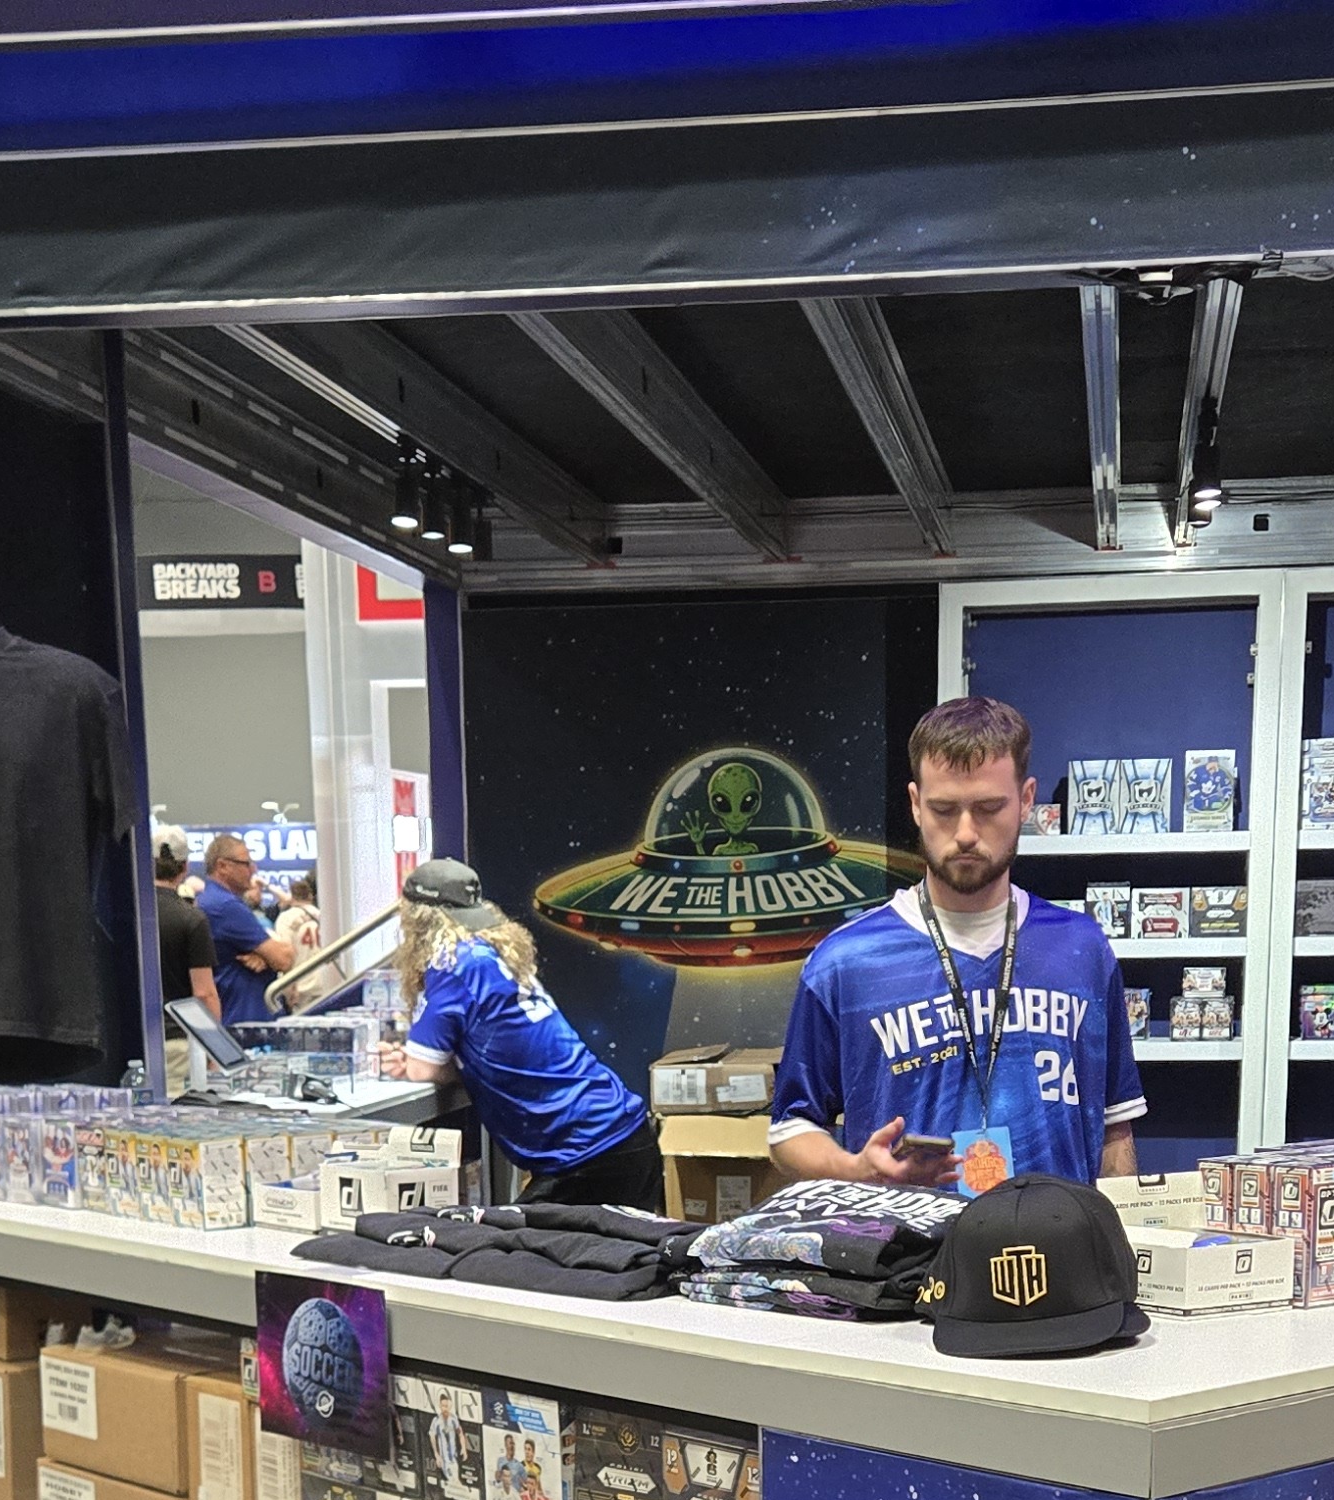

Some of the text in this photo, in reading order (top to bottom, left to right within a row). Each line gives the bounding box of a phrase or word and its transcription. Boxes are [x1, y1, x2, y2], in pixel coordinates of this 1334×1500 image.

[152, 562, 240, 580] BACKYARD
[257, 570, 277, 593] B
[153, 579, 242, 600] BREAKS
[610, 862, 867, 914] WE THE HOBBY
[870, 1000, 939, 1060] WE
[971, 987, 1089, 1042] HOBBY
[891, 1045, 959, 1076] EST. 2021
[1034, 1050, 1080, 1106] 26
[432, 1184, 449, 1193] FIFA
[288, 1342, 359, 1394] SOCCER
